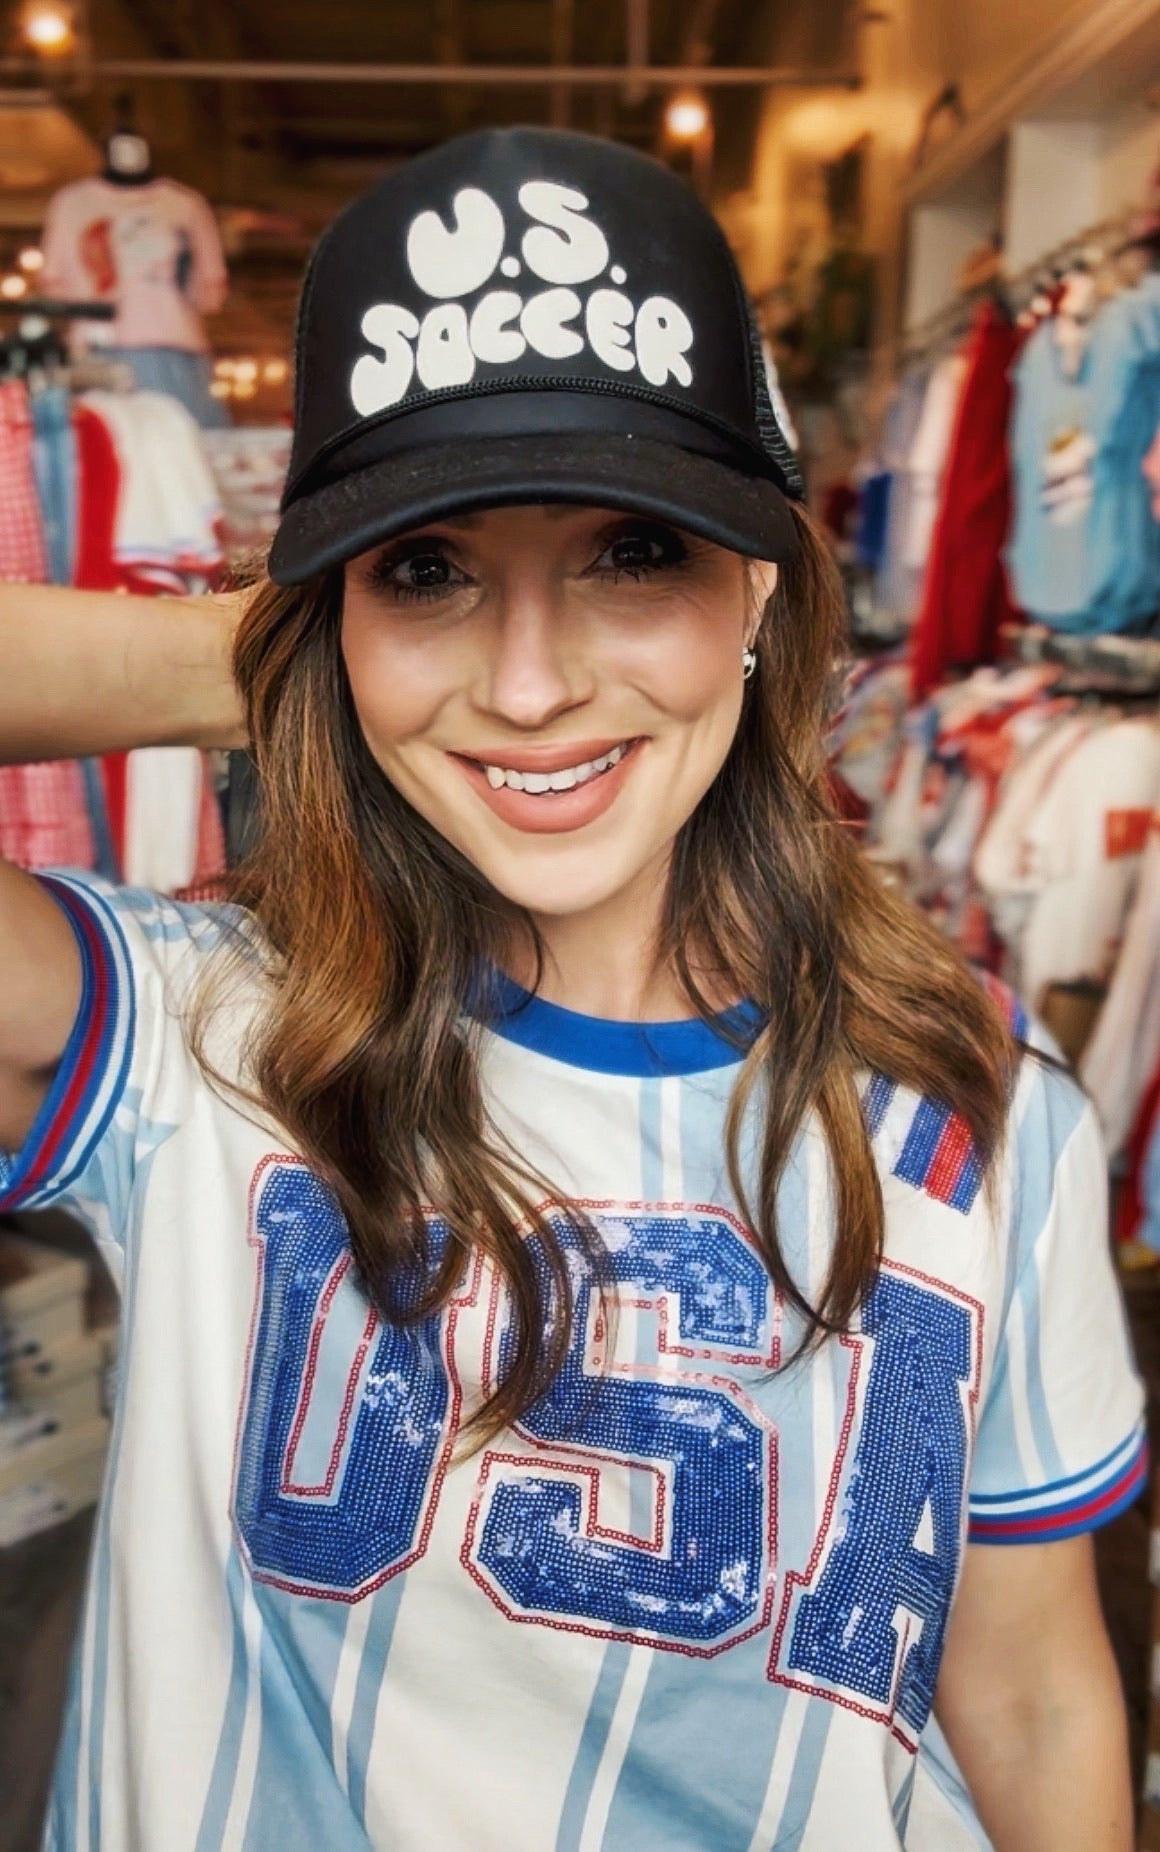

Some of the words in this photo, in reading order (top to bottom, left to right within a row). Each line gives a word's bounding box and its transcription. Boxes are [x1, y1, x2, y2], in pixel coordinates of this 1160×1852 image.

[407, 181, 627, 299] U.S.
[350, 287, 694, 417] SOCCER
[230, 1153, 984, 1754] USA
